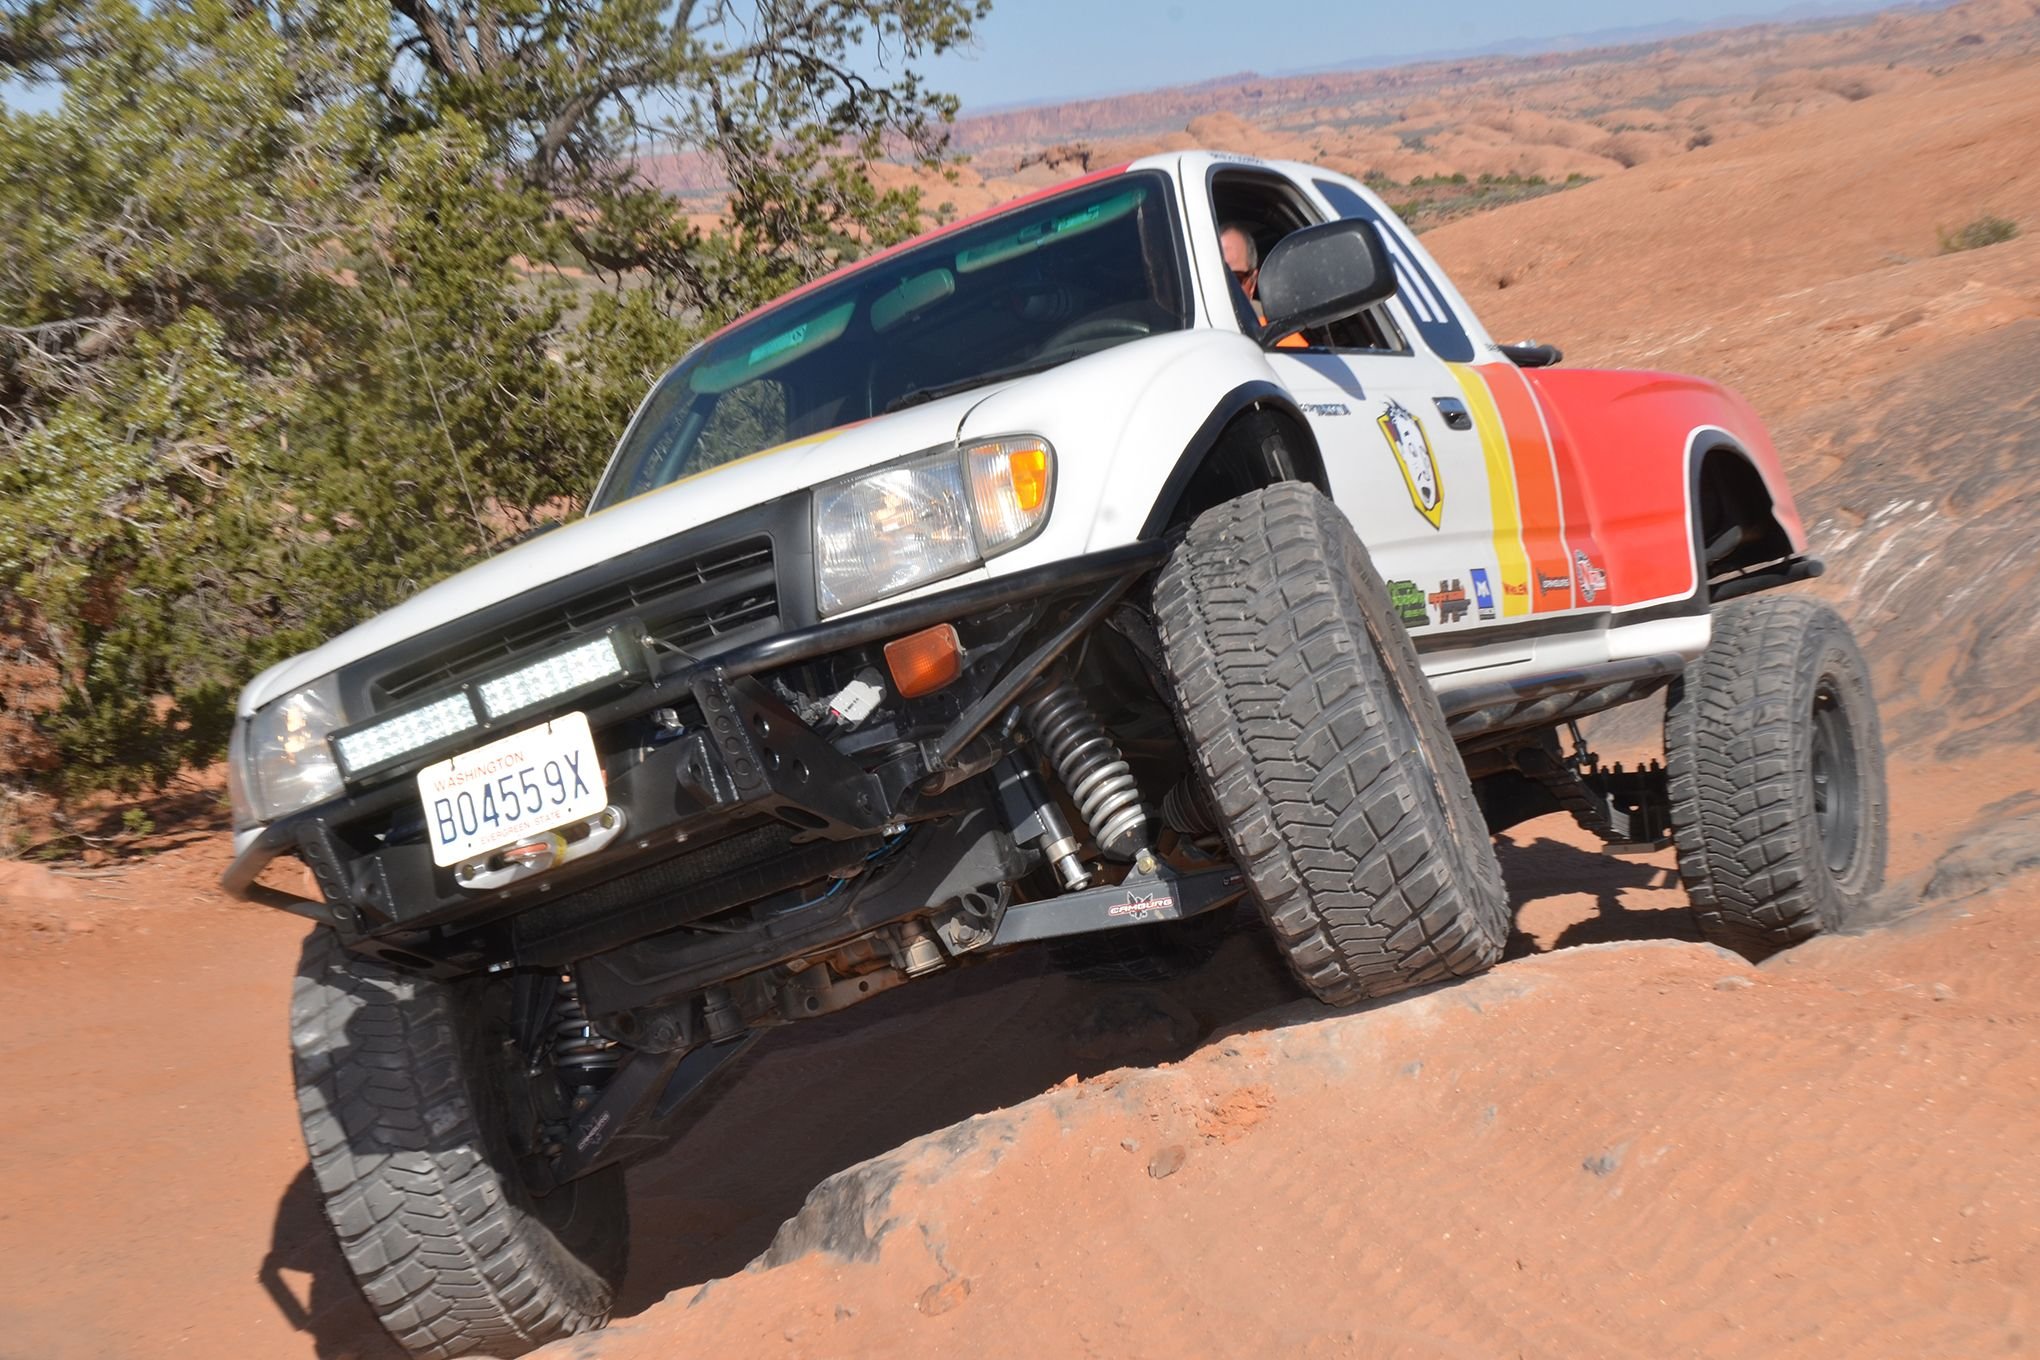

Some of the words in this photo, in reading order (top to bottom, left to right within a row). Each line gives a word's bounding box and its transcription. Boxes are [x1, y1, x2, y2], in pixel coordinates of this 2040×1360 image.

[434, 751, 525, 793] WASHINGTON
[434, 750, 589, 845] B04559X
[480, 821, 531, 845] EVERGREEN
[534, 809, 561, 826] STATE
[1110, 898, 1173, 914] CAMBURG
